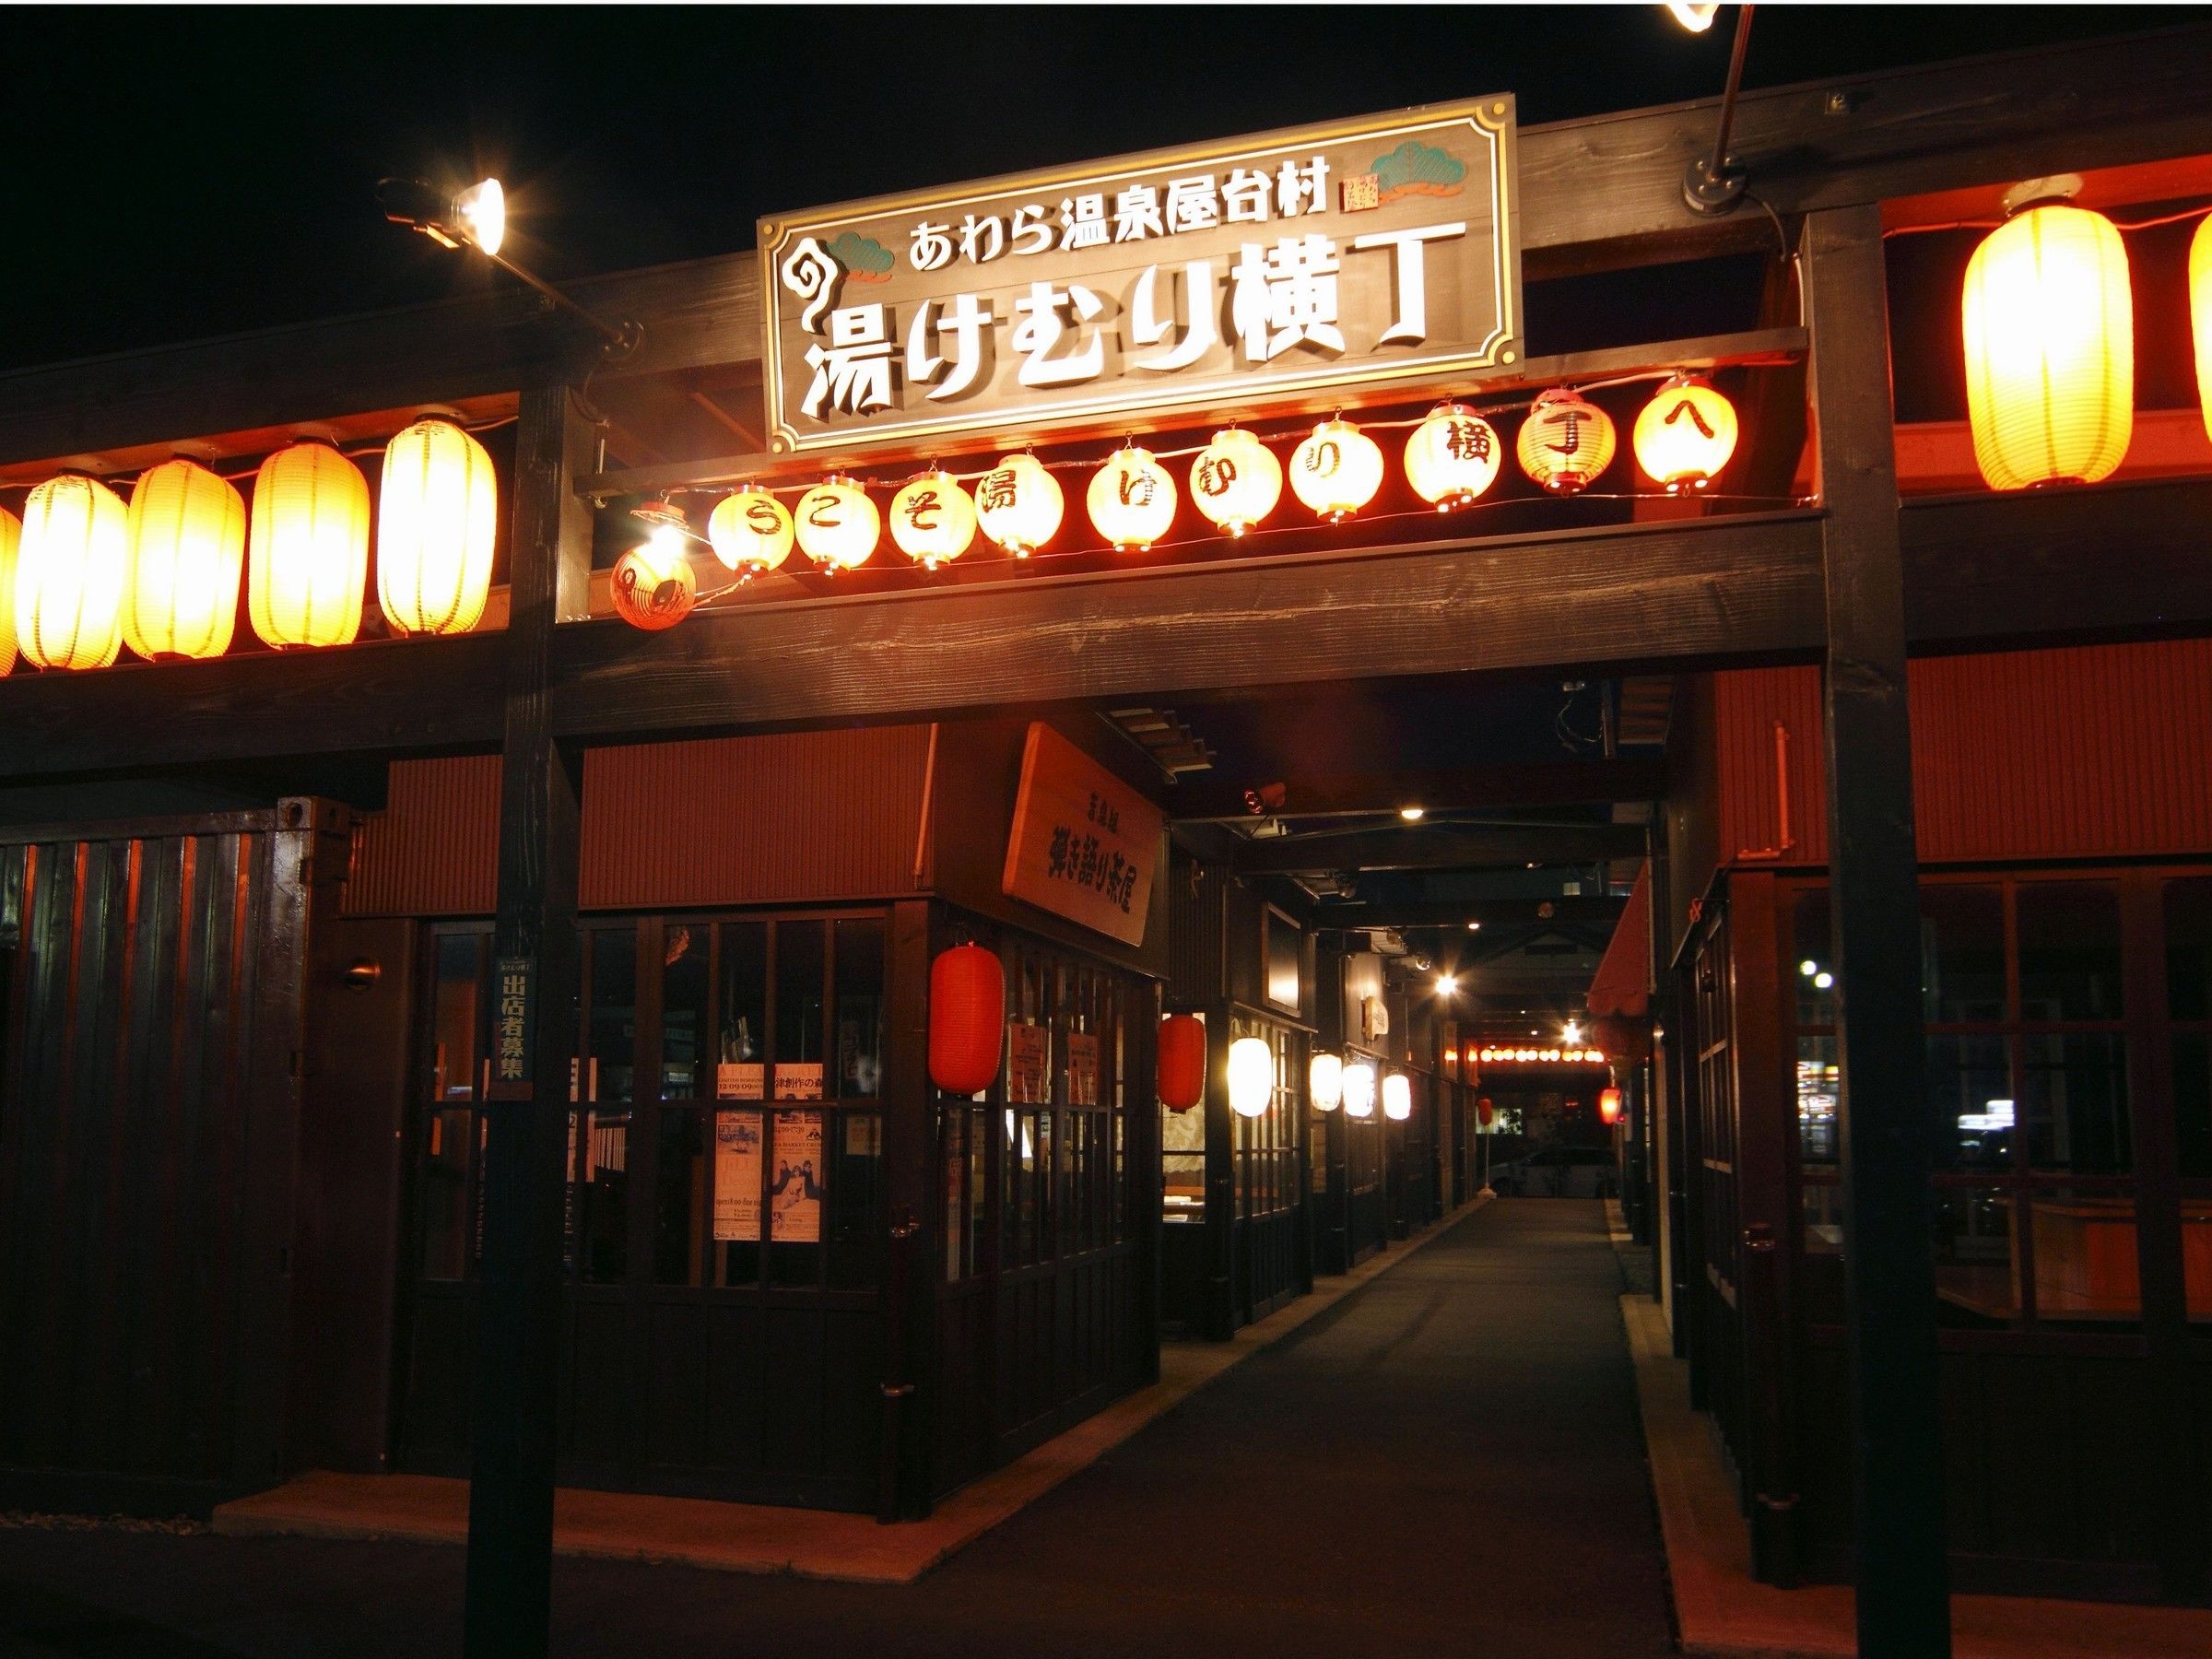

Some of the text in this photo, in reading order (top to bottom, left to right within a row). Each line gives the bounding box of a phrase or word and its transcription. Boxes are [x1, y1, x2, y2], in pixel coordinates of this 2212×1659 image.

[909, 156, 1331, 272] あわら温泉屋台村
[803, 222, 1466, 418] 湯けむり横丁
[500, 974, 526, 1078] 出店者募集
